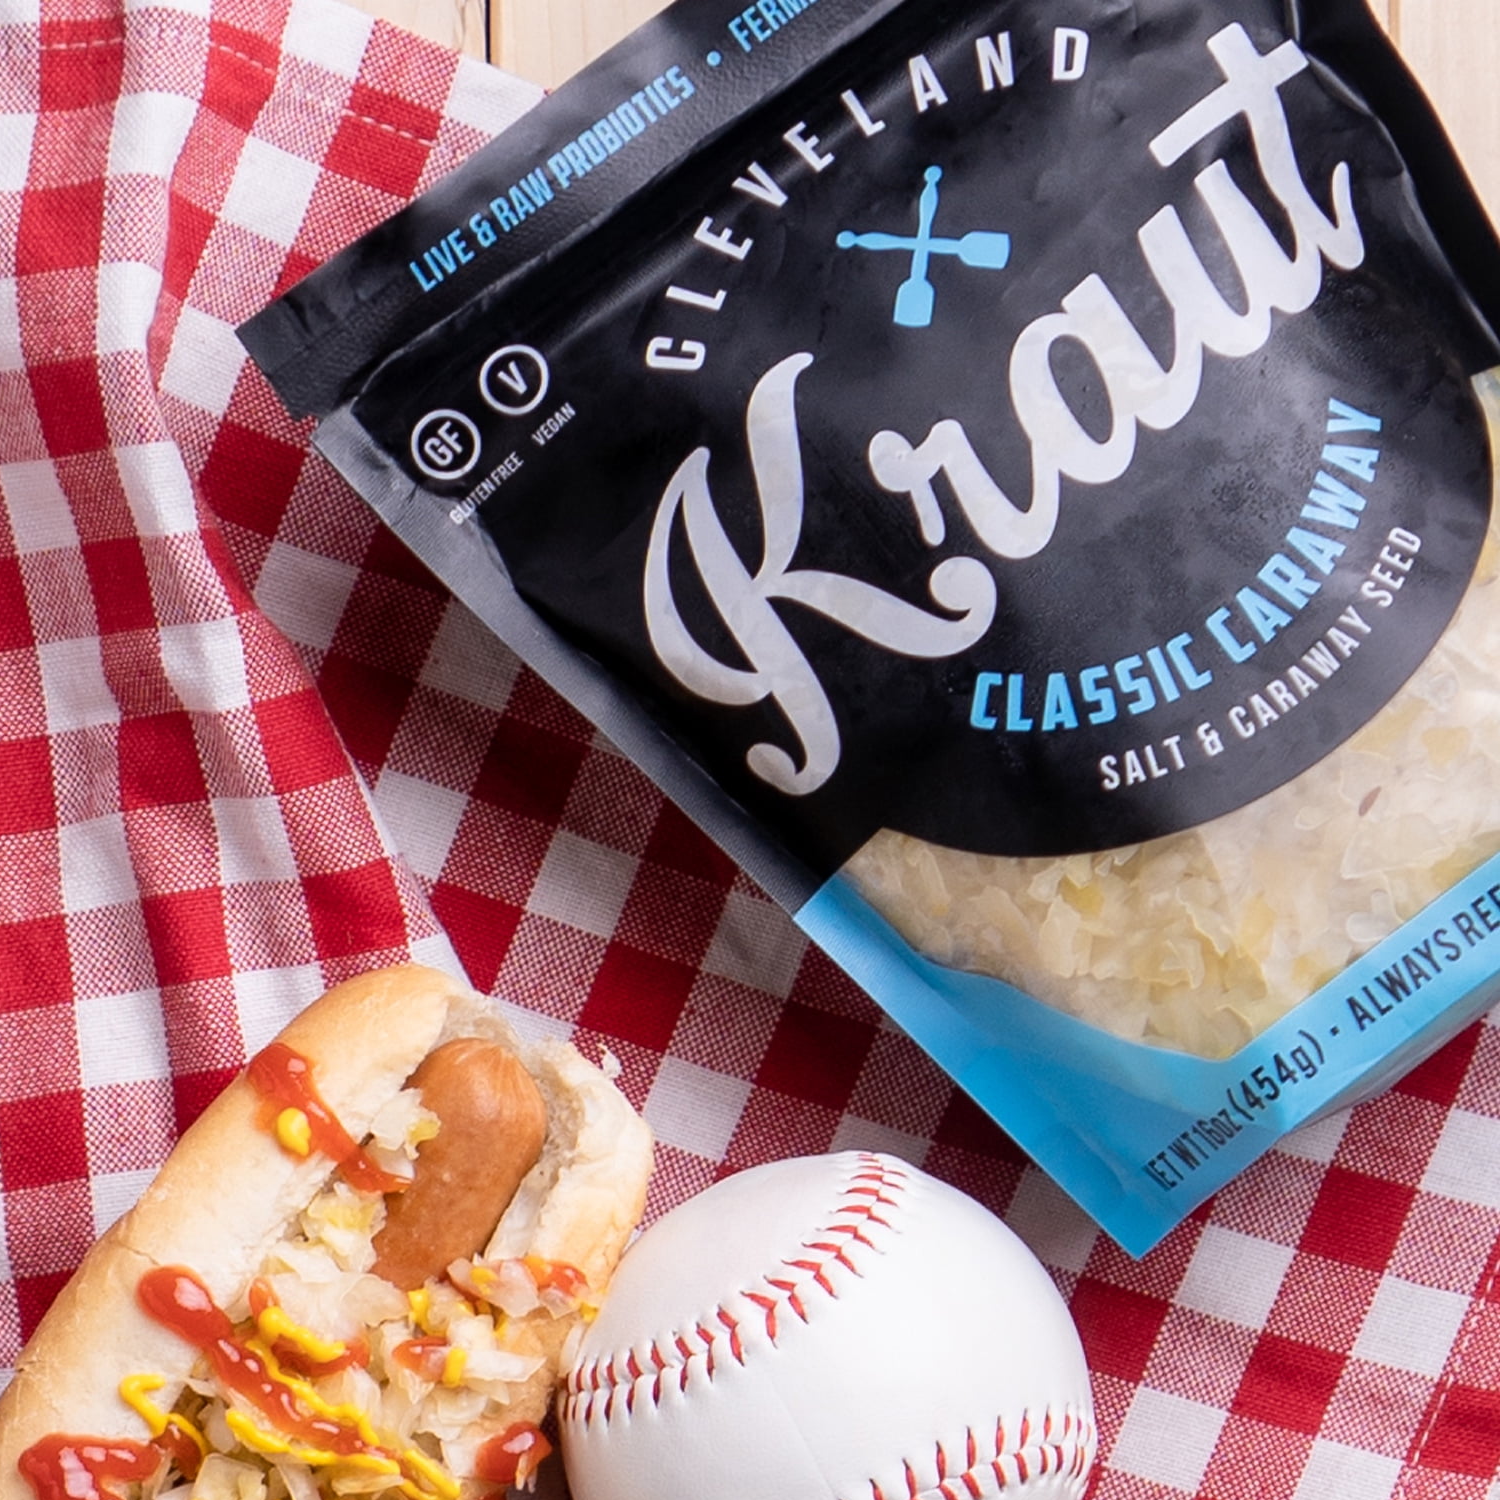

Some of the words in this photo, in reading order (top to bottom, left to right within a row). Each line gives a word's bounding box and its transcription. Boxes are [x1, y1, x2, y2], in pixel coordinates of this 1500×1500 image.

[409, 228, 475, 292] LIVE
[469, 212, 498, 249] &
[489, 167, 555, 232] RAW
[547, 64, 696, 189] PROBIOTICS
[646, 27, 1089, 371] CLEVELAND
[423, 420, 464, 467] GF
[449, 477, 497, 525] GLUTEN
[491, 451, 525, 487] FREE
[497, 360, 528, 395] V
[531, 402, 577, 447] VEGAN
[644, 22, 1365, 796] Kraut
[969, 631, 1213, 732] CLASSIC
[1205, 398, 1382, 664] CARAWAY
[1099, 735, 1187, 791] SALT
[1196, 721, 1225, 758] &
[1228, 605, 1372, 740] CARAWAY
[1361, 526, 1422, 608] SEED
[1167, 1131, 1210, 1171] WT
[1226, 1029, 1326, 1122] (454g)
[1345, 927, 1462, 1033] ALWAYS
